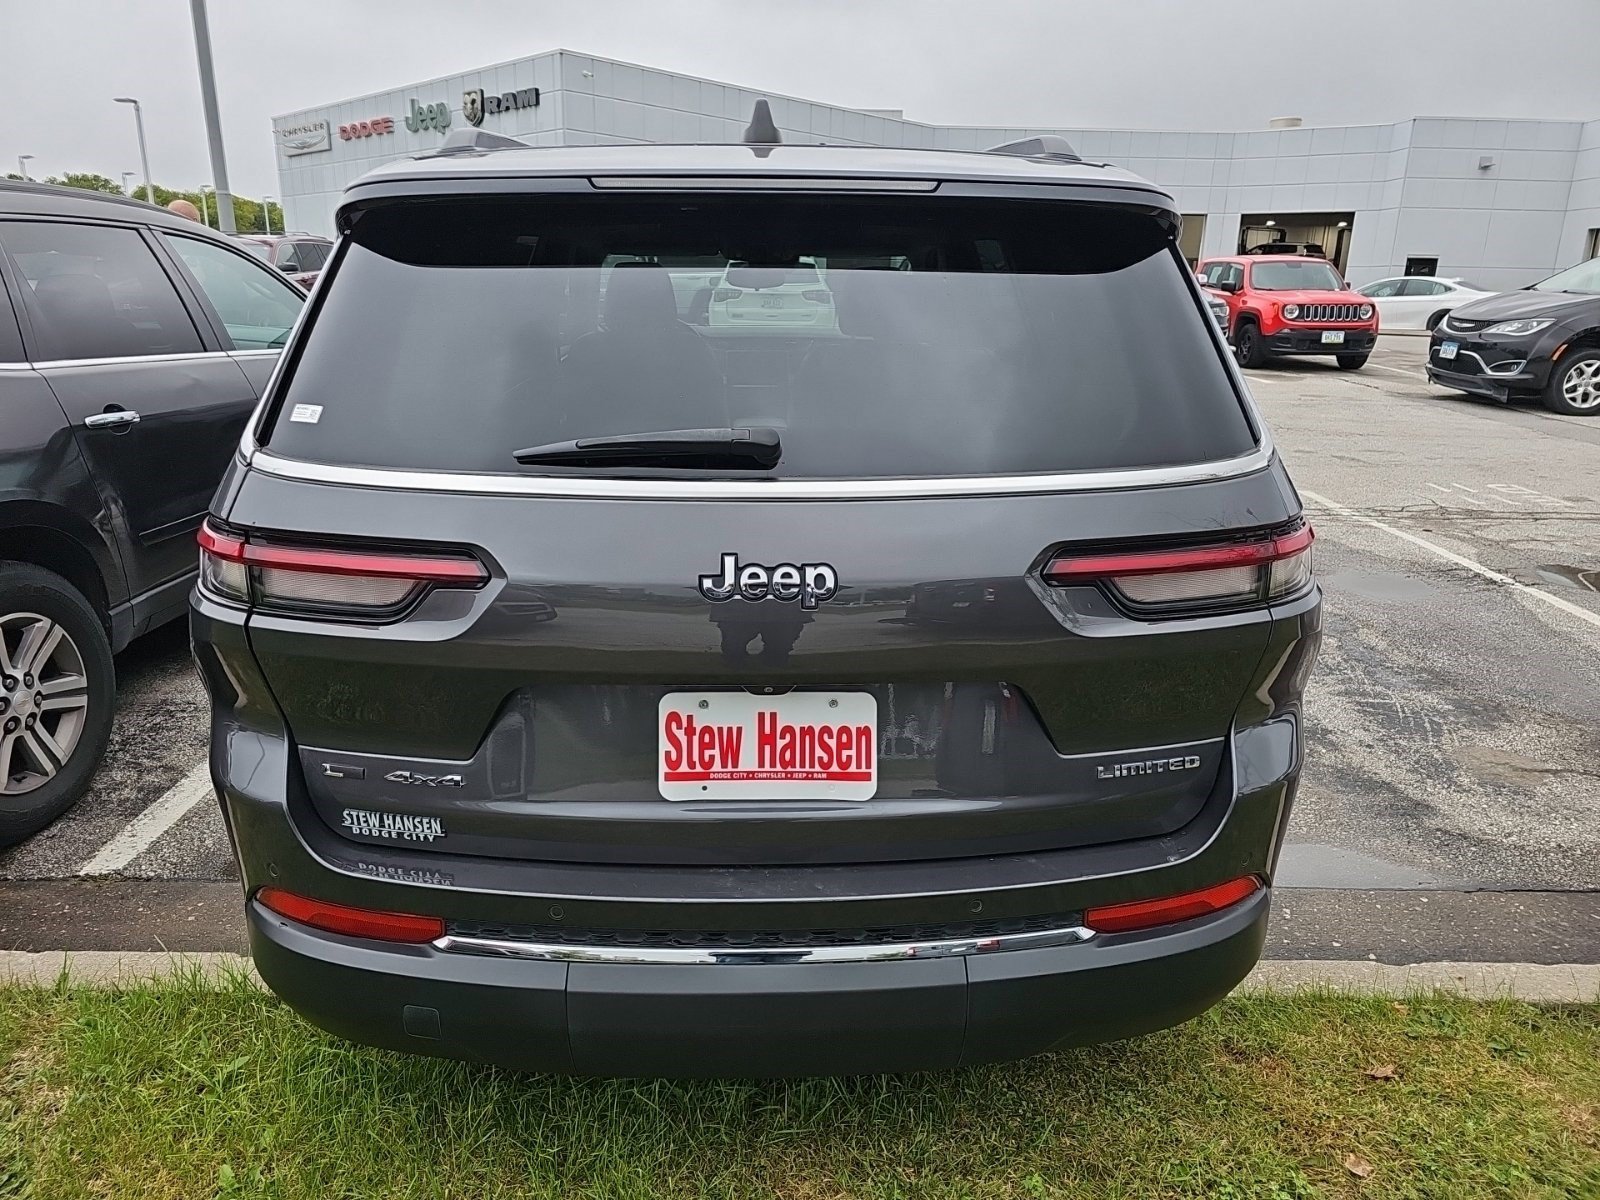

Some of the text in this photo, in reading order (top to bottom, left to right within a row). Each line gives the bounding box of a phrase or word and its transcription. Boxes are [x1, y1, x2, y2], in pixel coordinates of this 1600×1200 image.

[484, 87, 540, 114] RAM
[338, 116, 395, 141] DODGE
[404, 98, 452, 134] Jeep
[281, 122, 325, 137] CHRYSLER
[698, 552, 839, 611] Jeep
[664, 711, 872, 771] Stew Hansen
[709, 772, 731, 780] DODGE
[733, 772, 748, 780] CITY
[1097, 755, 1201, 779] LIMITED
[342, 809, 442, 834] STEW HANSEN
[352, 827, 435, 843] DODGE CITY
